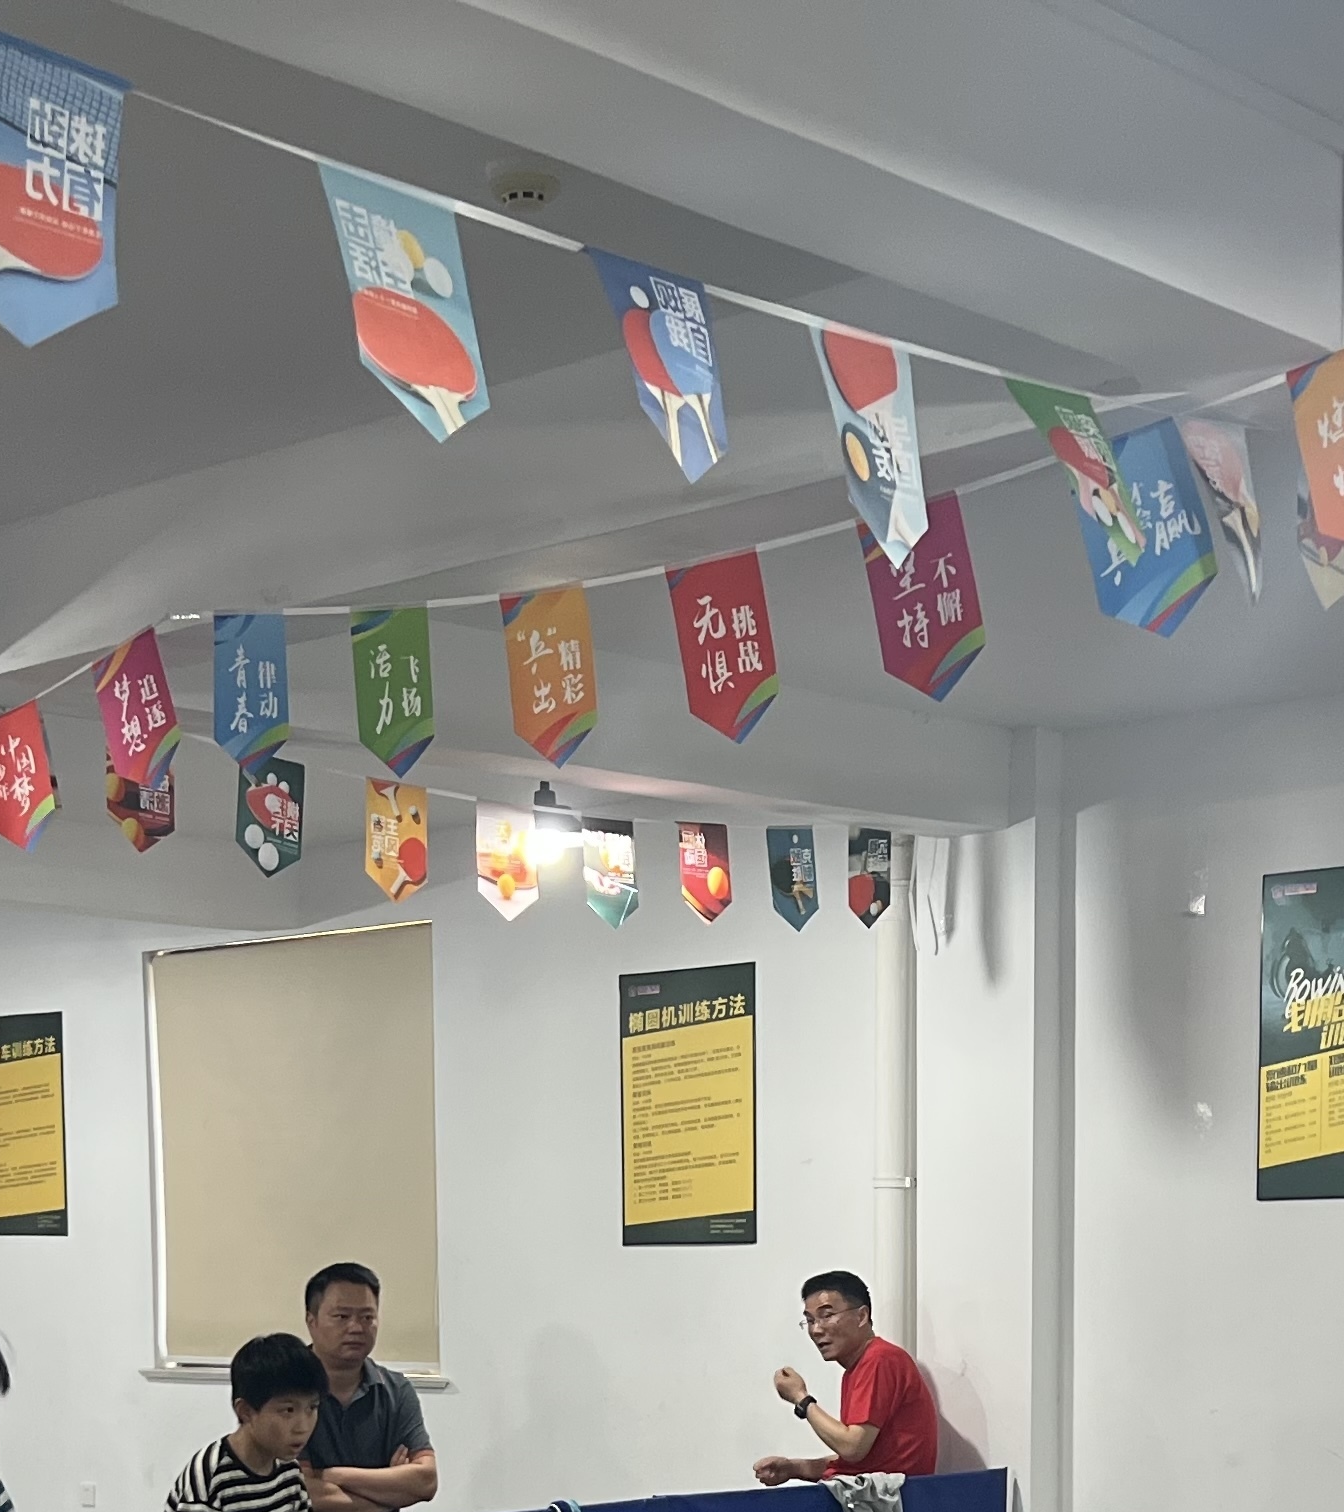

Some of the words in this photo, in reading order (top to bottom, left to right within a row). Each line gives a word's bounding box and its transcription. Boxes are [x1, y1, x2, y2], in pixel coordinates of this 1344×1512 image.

[929, 551, 964, 627] 不懈
[558, 636, 587, 706] 精彩
[692, 595, 733, 697] 无惧
[731, 605, 763, 674] 挑战
[228, 644, 254, 735] 青春
[257, 660, 280, 720] 律动
[368, 642, 393, 736] 活力
[399, 654, 423, 718] 飞扬
[628, 992, 748, 1035] 椭圆机训练方法
